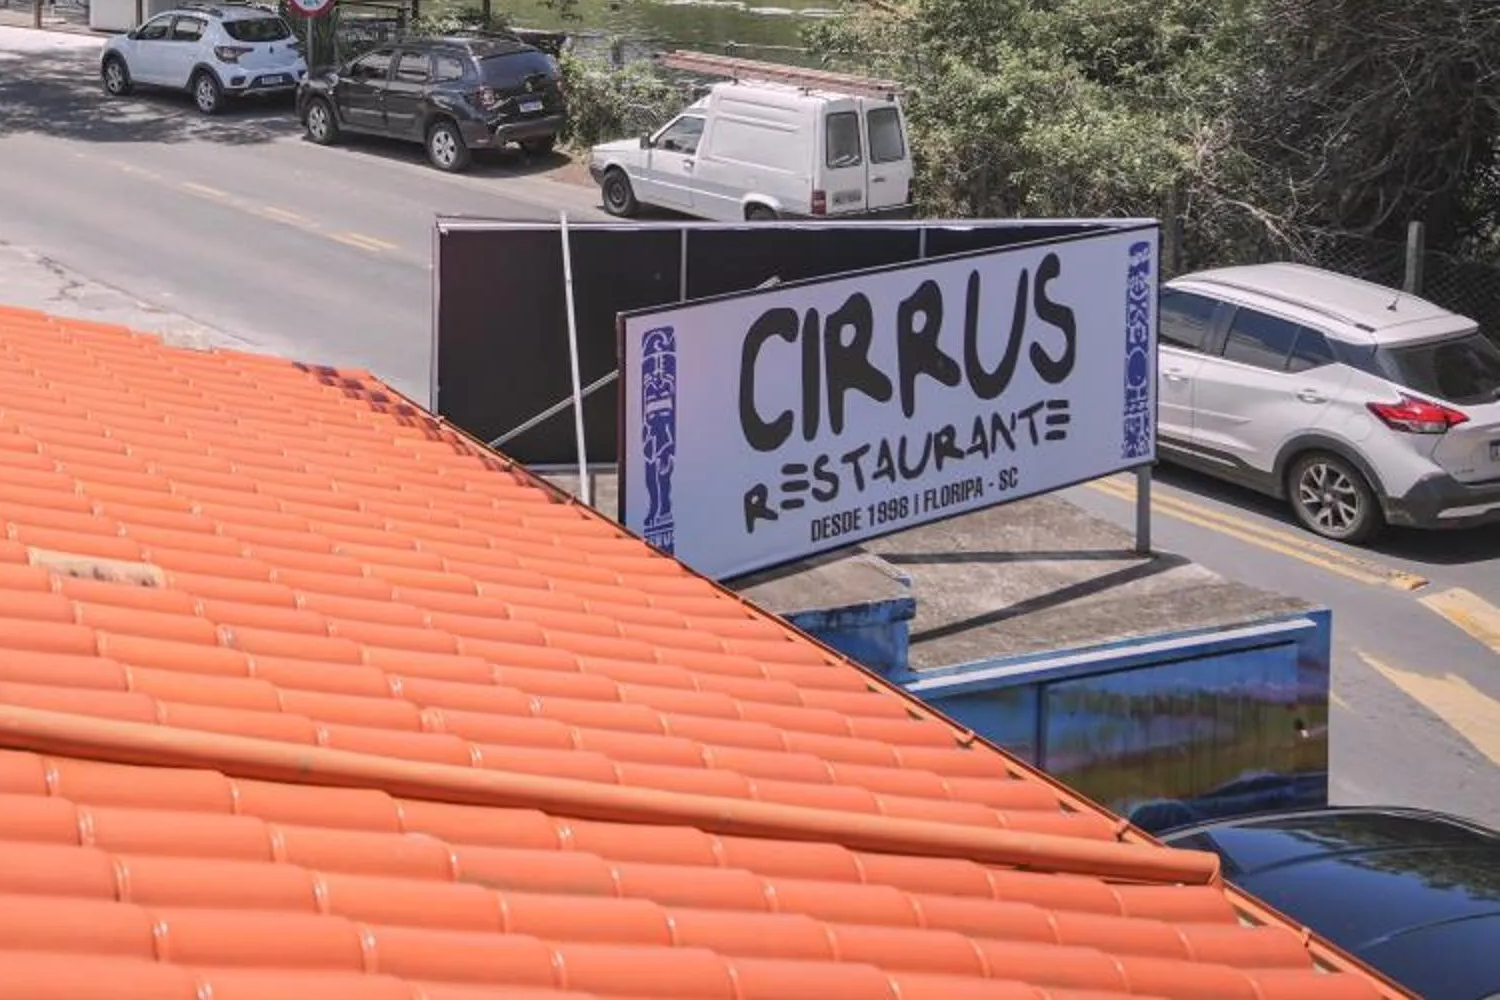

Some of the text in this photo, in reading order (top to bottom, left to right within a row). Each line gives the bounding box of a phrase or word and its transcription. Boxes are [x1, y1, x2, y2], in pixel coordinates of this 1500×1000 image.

[739, 252, 1077, 452] CIRRUS
[743, 400, 1071, 533] RESTAURANTE
[811, 507, 863, 543] DESDE
[867, 494, 910, 528] 1998
[923, 476, 984, 513] FLORIPA
[998, 466, 1019, 492] SC
